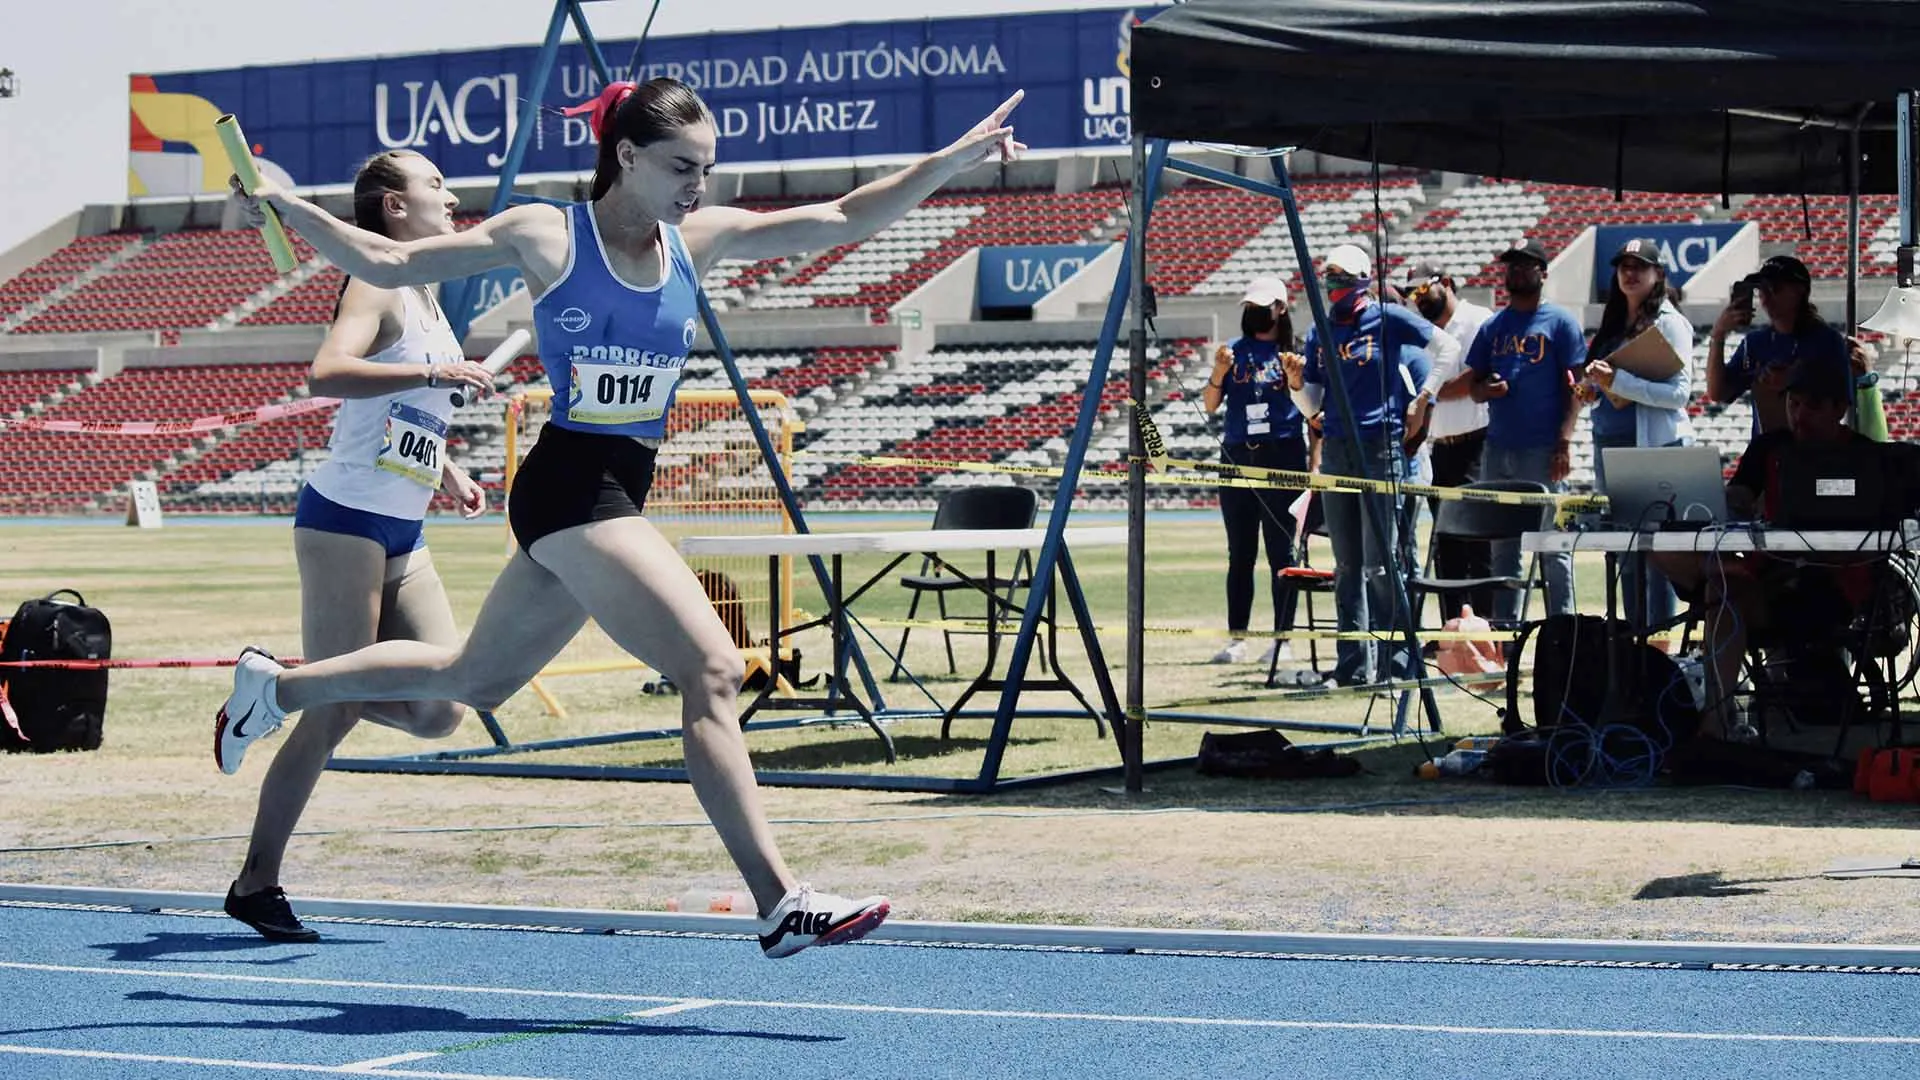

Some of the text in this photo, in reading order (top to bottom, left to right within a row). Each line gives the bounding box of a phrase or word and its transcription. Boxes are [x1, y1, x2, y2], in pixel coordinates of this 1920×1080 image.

[797, 41, 1006, 84] AUTÓNOMA
[375, 73, 518, 168] UACJ
[757, 97, 878, 143] JUÁREZ
[597, 373, 655, 405] 0114
[398, 430, 437, 469] 0401
[763, 910, 832, 946] AIR
